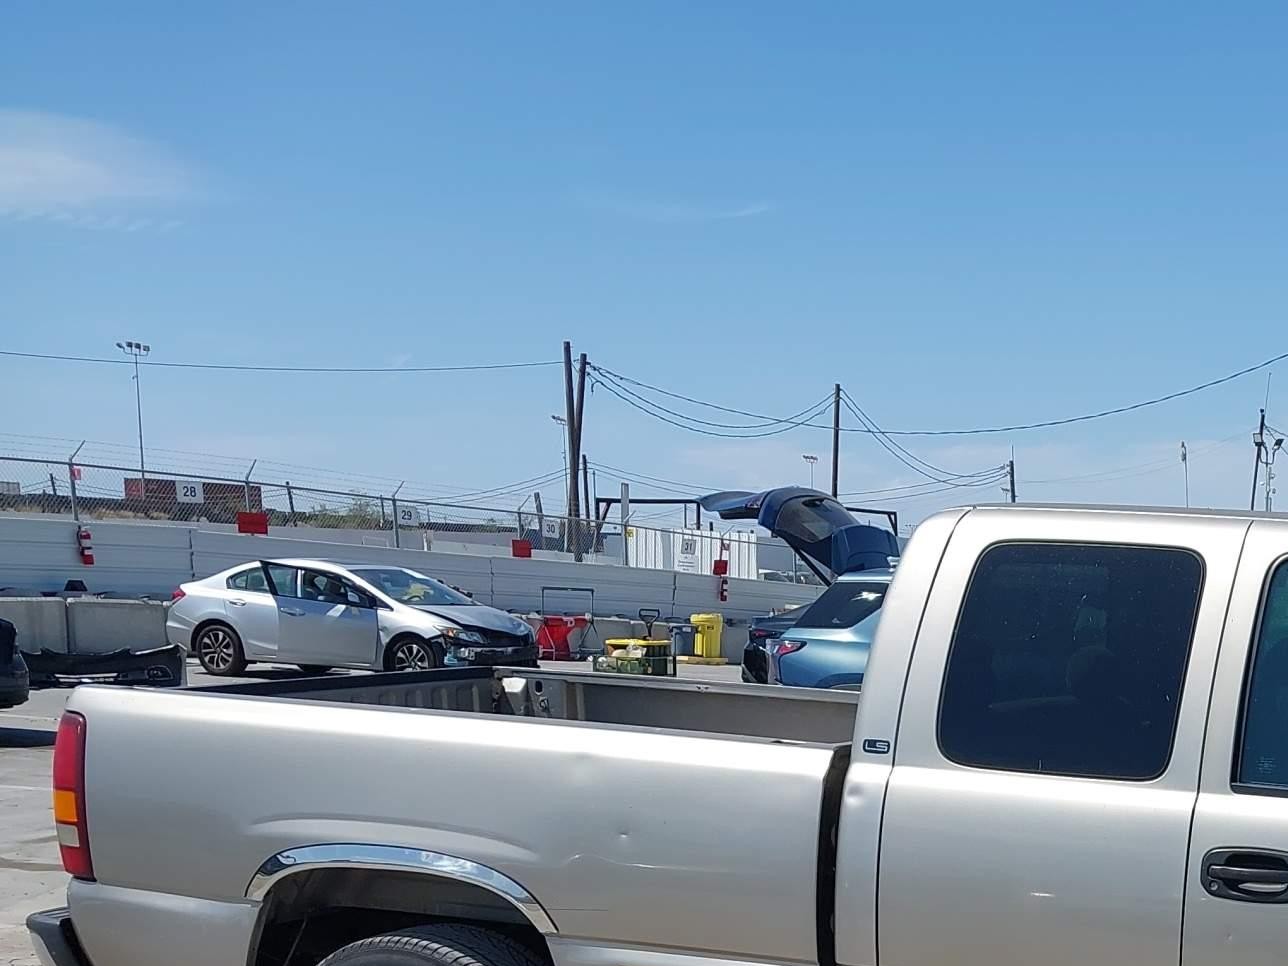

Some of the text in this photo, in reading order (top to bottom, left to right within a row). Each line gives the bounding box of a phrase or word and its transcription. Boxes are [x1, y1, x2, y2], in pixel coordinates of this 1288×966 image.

[182, 485, 197, 498] 28
[401, 509, 412, 521] 29
[546, 523, 556, 534] 30
[684, 542, 693, 551] 31
[865, 740, 889, 752] LS
